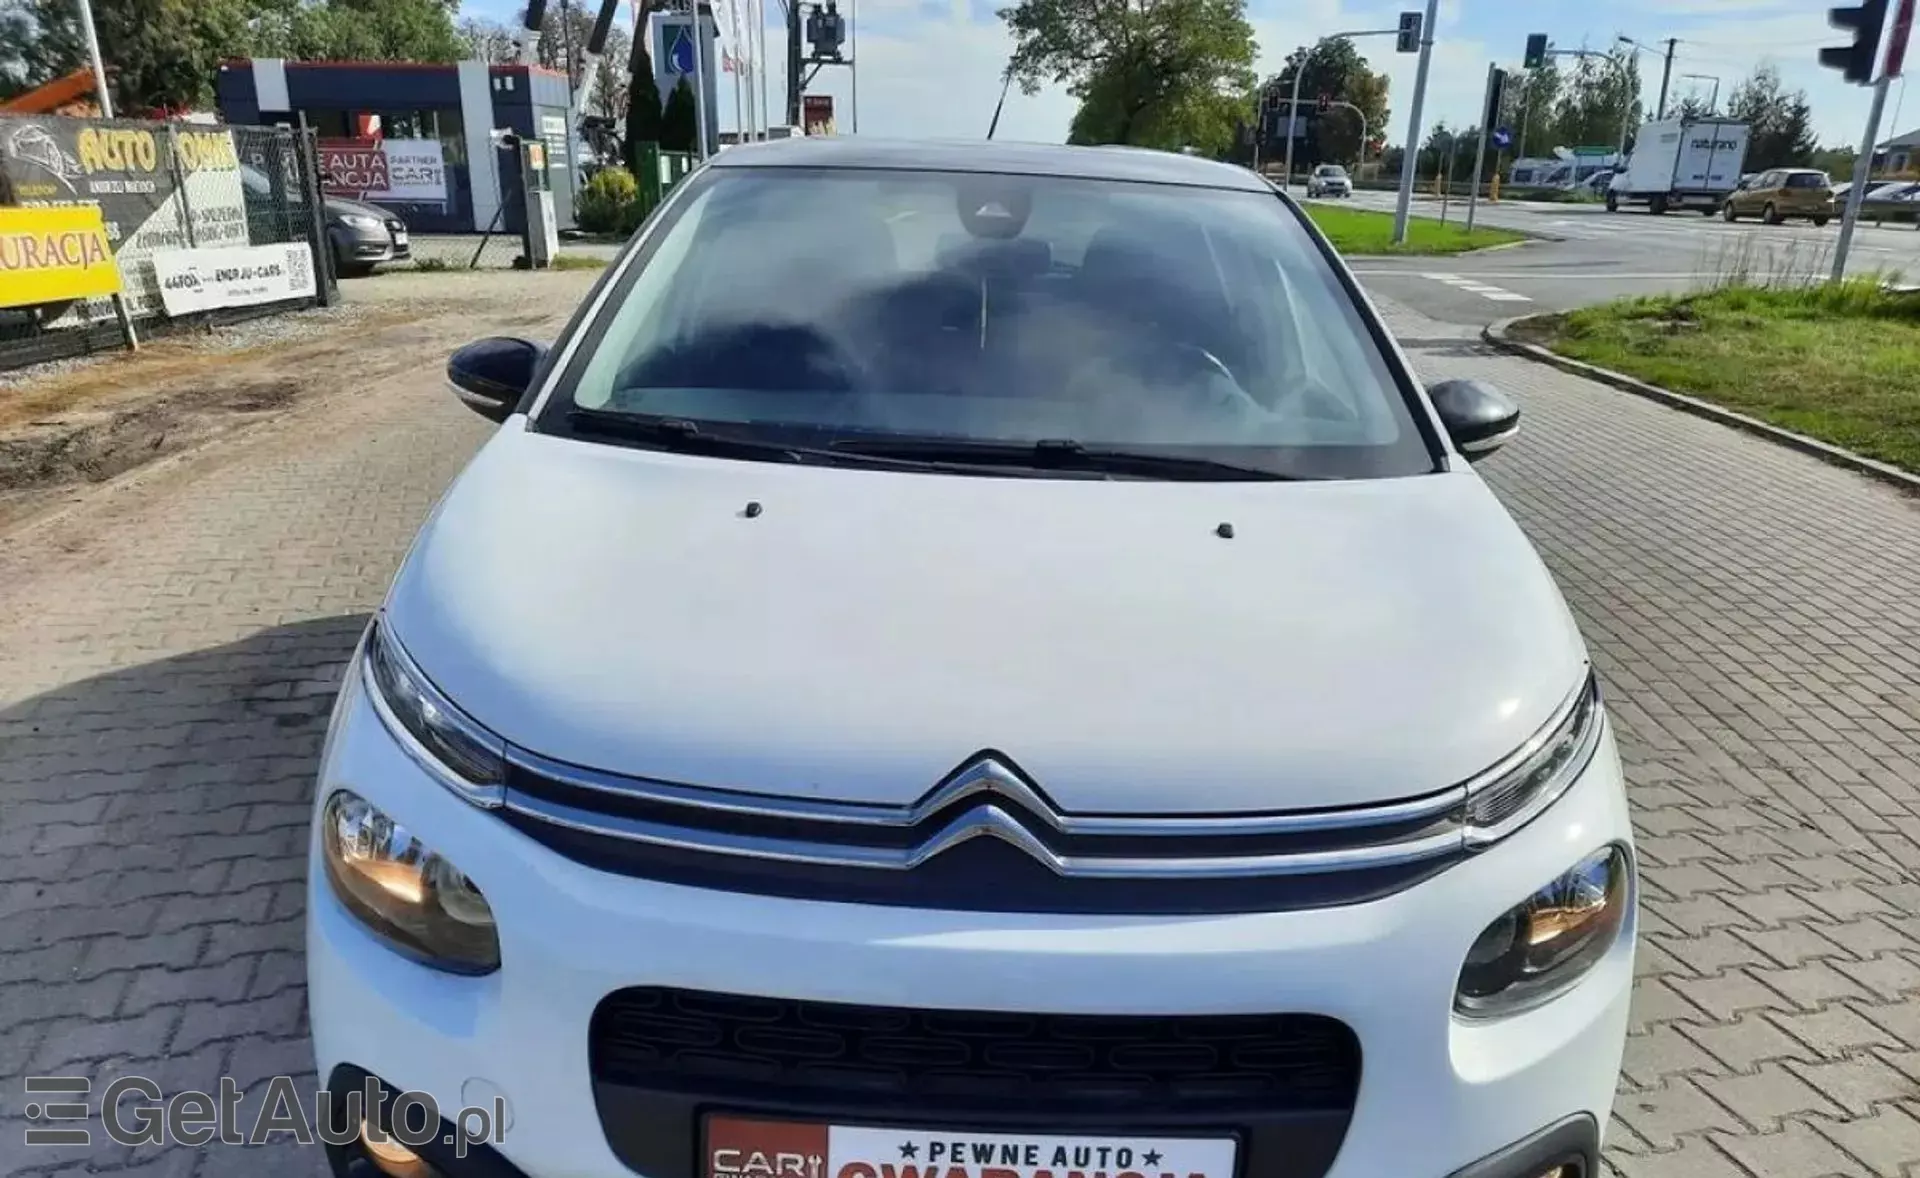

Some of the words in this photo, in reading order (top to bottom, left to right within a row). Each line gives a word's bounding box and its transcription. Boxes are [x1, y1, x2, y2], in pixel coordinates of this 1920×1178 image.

[79, 128, 156, 174] AUTO
[330, 153, 385, 169] AUTA
[392, 166, 433, 181] CAR
[713, 1148, 805, 1176] CAR
[928, 1141, 1040, 1167] PEWNE
[1050, 1145, 1134, 1170] AUTO
